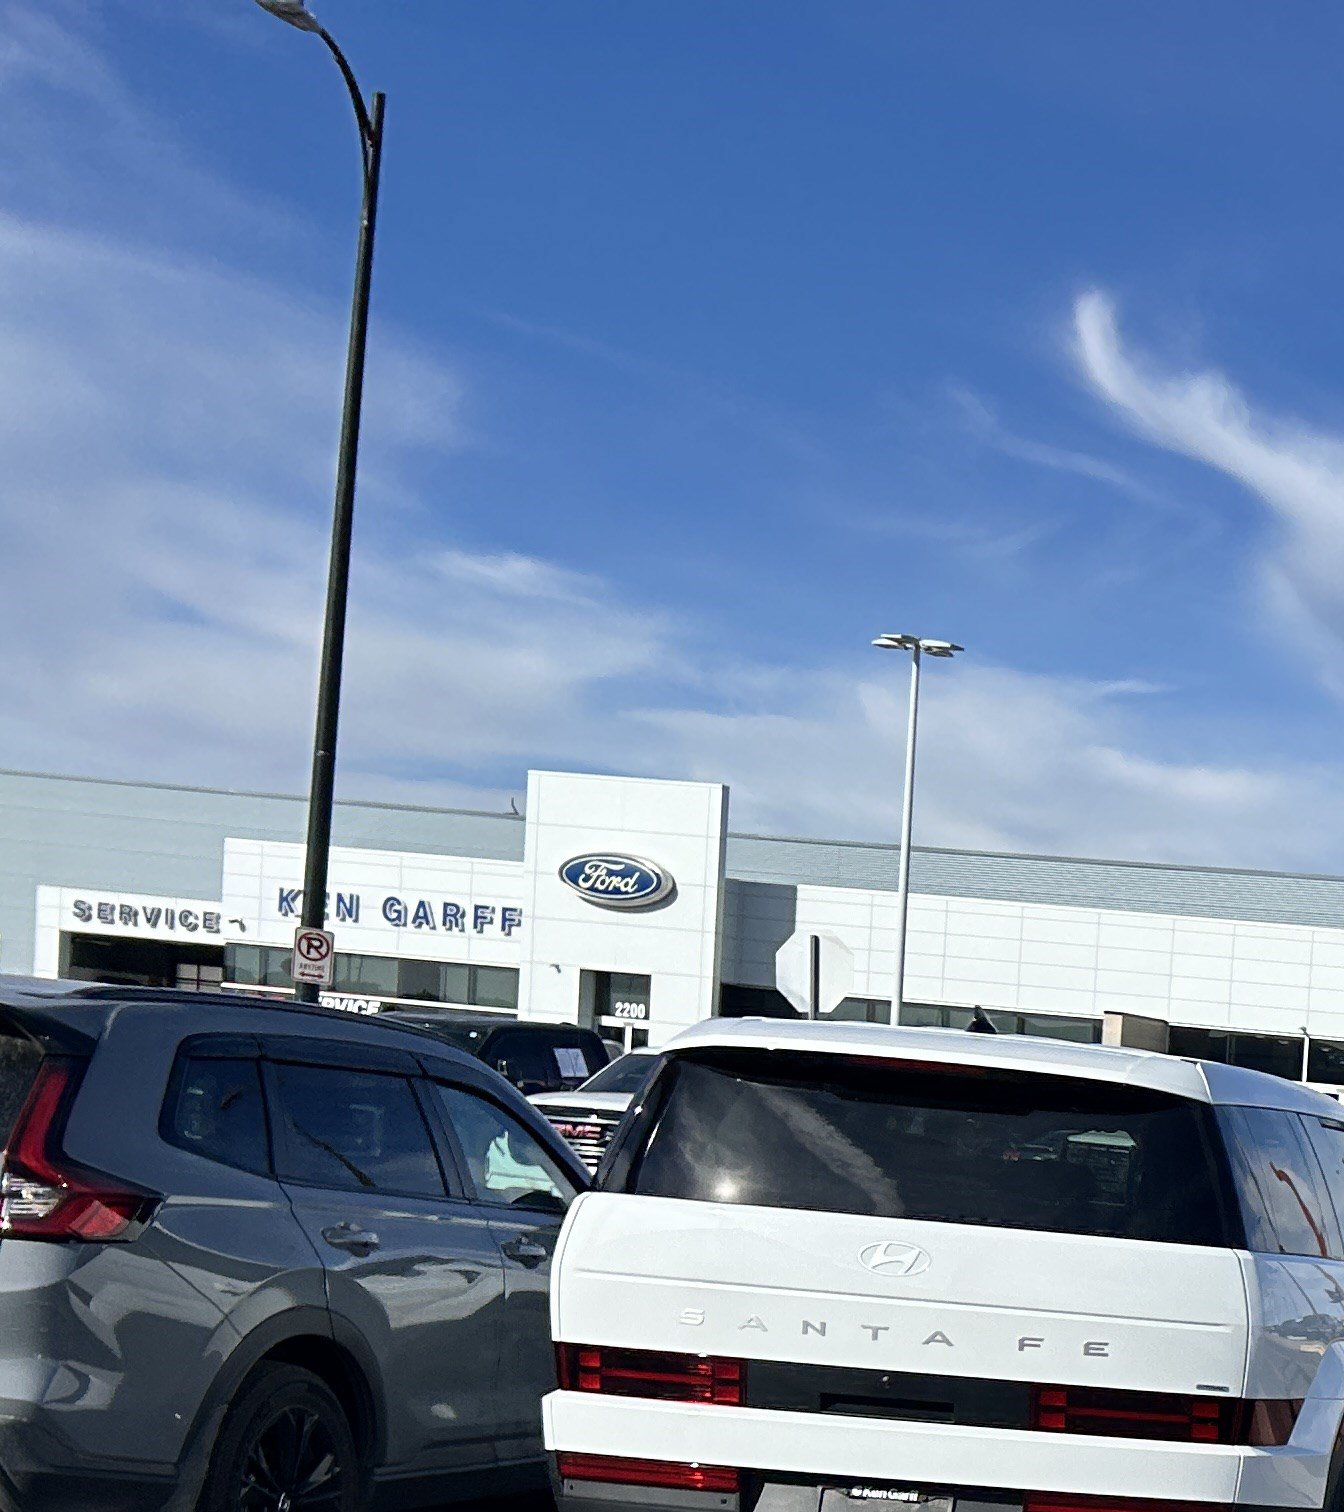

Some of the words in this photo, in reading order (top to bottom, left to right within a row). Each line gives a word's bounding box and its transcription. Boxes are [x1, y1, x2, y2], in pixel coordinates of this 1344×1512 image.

[578, 860, 641, 893] Ford
[72, 898, 222, 934] SERVICE
[278, 887, 360, 924] KN
[382, 896, 522, 937] GARFF
[614, 1001, 647, 1019] 2200
[679, 1307, 955, 1347] SANTA
[1017, 1336, 1111, 1358] FE
